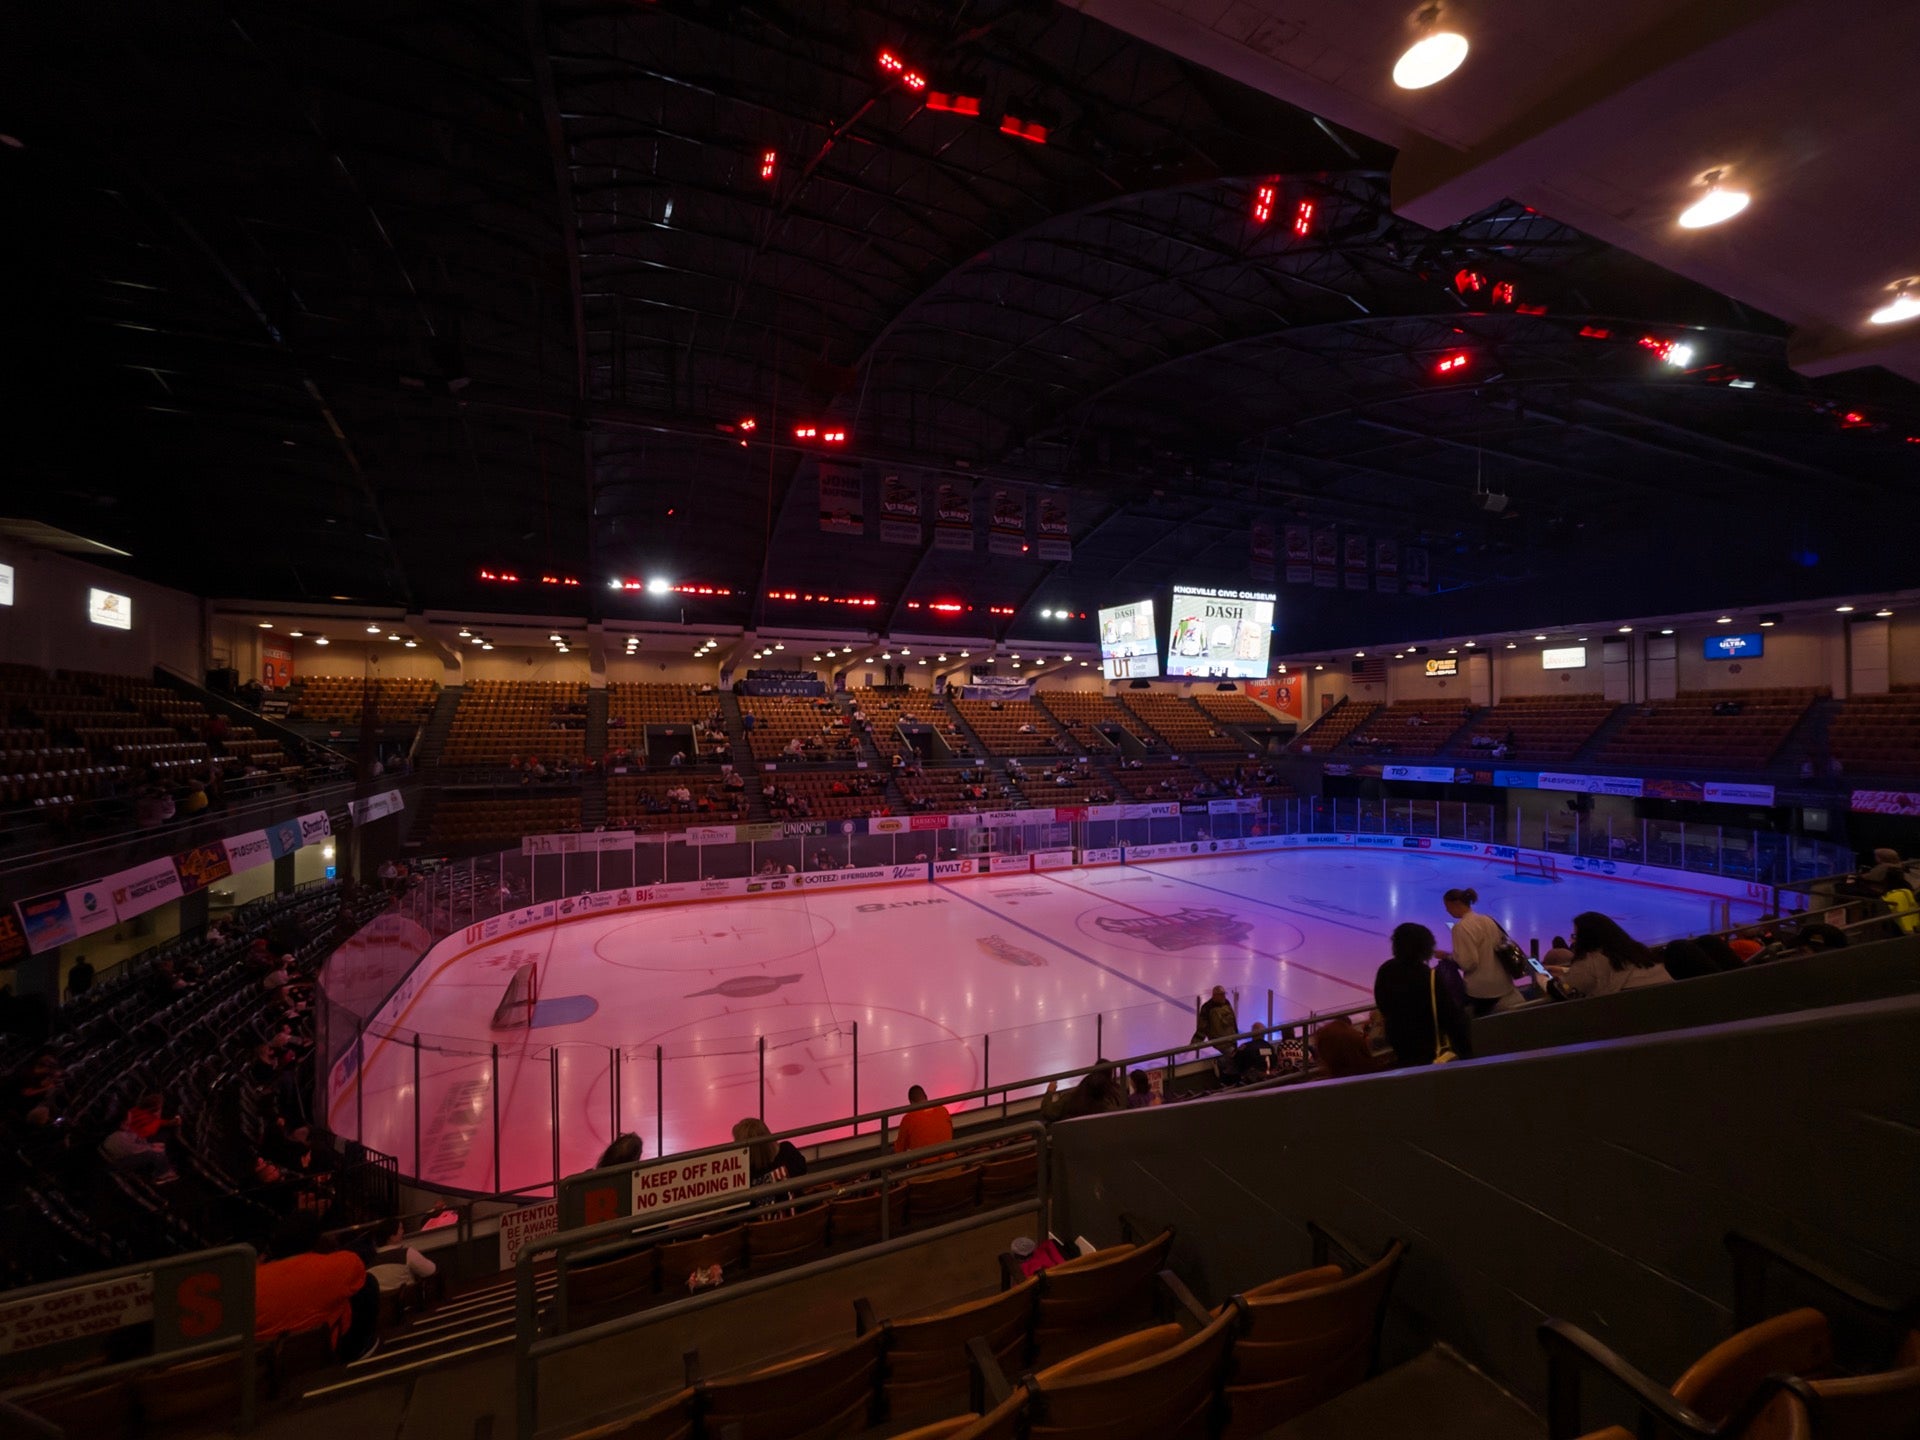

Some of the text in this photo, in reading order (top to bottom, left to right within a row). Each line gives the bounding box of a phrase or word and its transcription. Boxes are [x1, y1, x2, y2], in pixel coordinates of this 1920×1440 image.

[1173, 585, 1277, 601] KNOXVILLE CIVIC COLISEUM
[1114, 608, 1135, 619] DASH
[1205, 605, 1243, 619] DASH
[1113, 658, 1131, 677] UT
[784, 822, 812, 835] UNION
[847, 870, 884, 880] FERGUSON
[466, 922, 484, 945] UT
[641, 1156, 741, 1190] KEEP OFF RAIL
[637, 1172, 746, 1210] NO STANDING IN
[585, 1186, 618, 1226] R
[507, 1226, 520, 1239] BE
[523, 1217, 559, 1236] AWARE
[507, 1238, 521, 1251] OF
[177, 1271, 224, 1338] S
